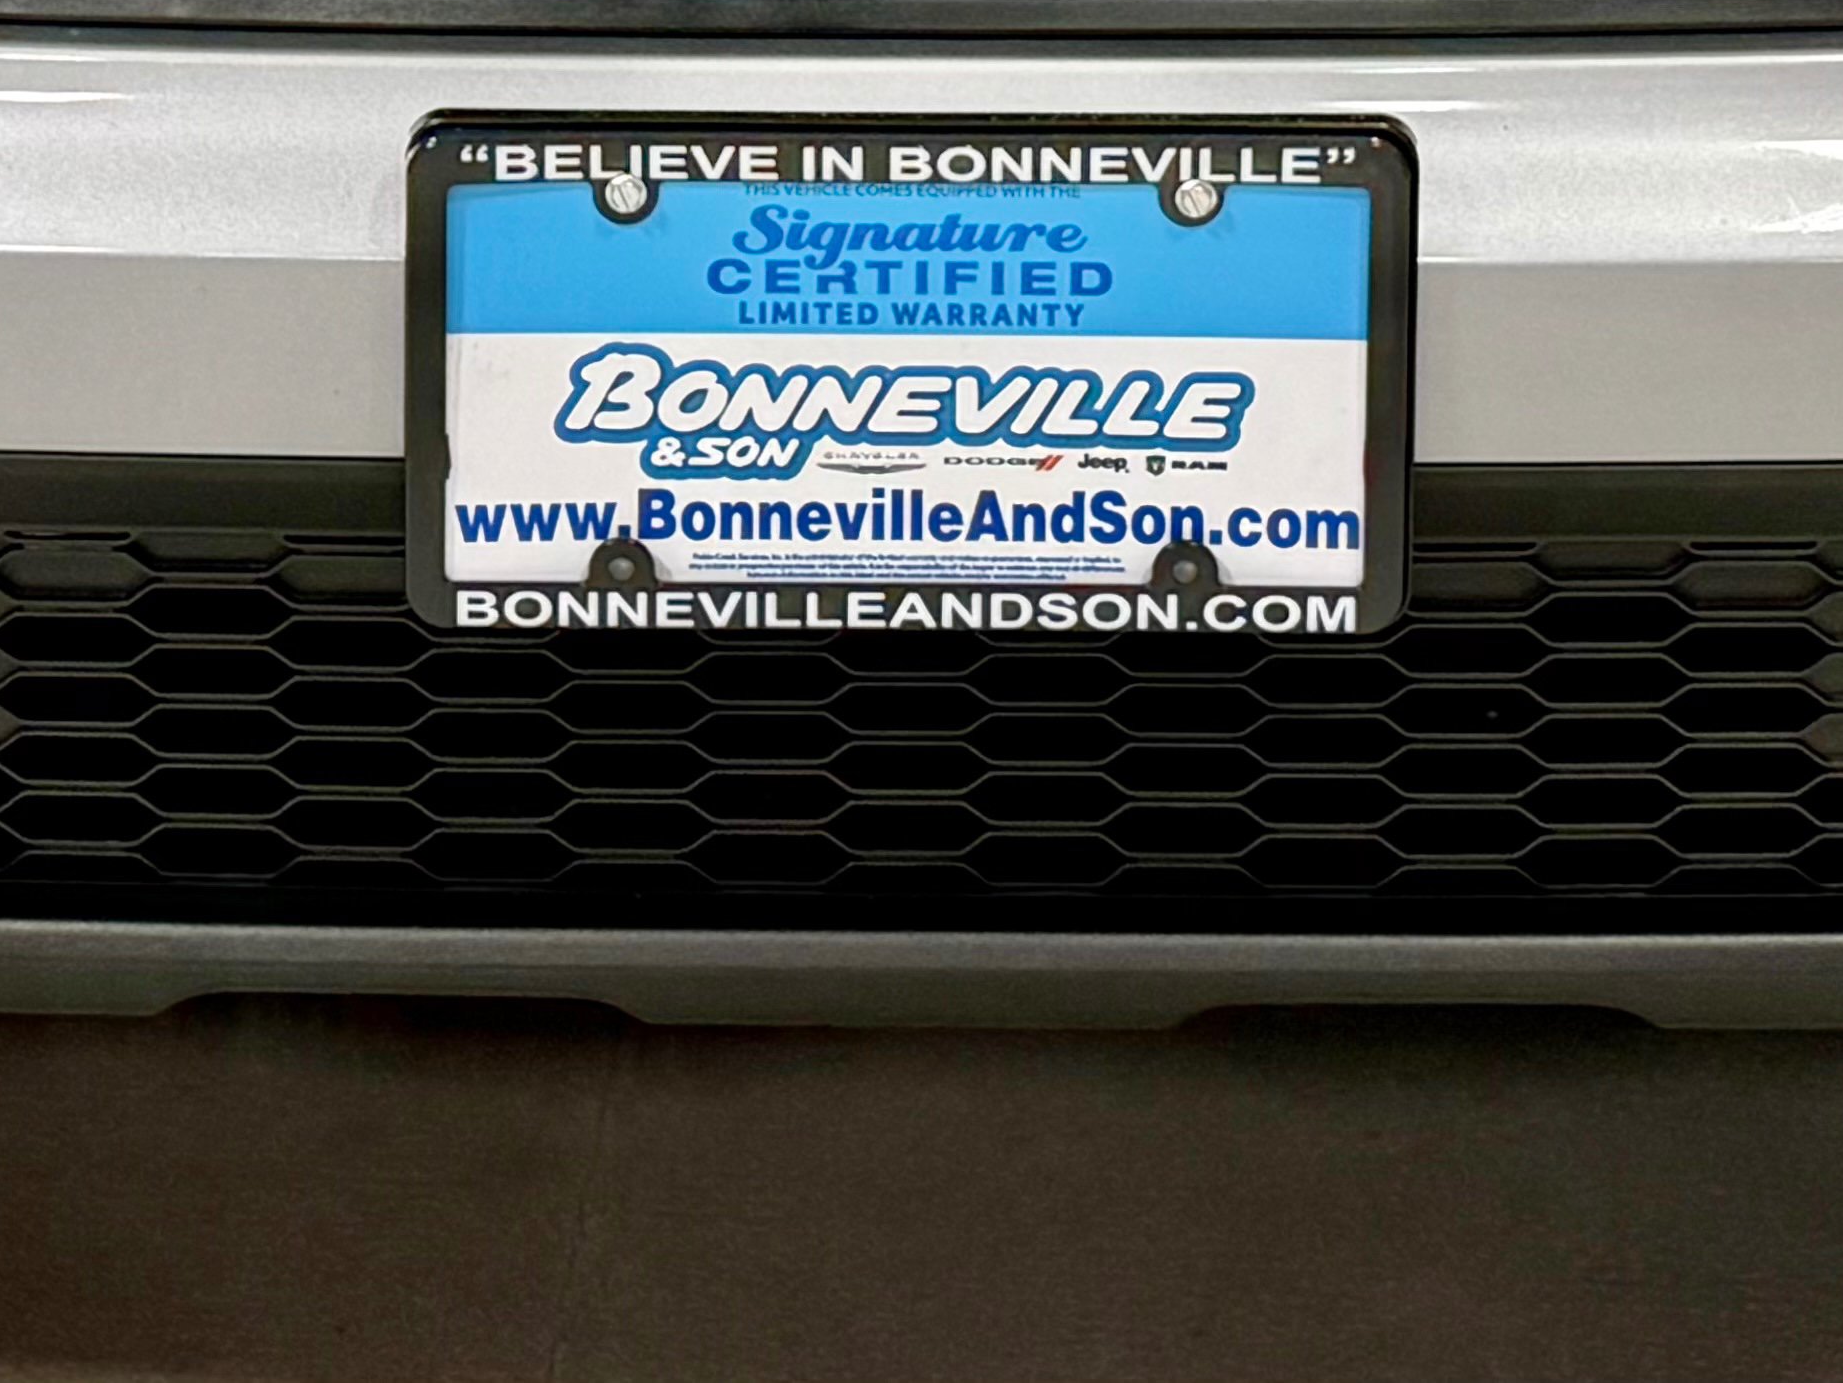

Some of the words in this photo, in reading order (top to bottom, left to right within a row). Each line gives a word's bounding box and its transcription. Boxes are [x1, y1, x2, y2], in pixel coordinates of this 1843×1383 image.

[459, 143, 780, 181] “BELIEVE
[802, 144, 864, 182] IN
[888, 144, 1357, 184] BONNEVILLE”
[745, 184, 780, 197] THIS
[783, 184, 851, 197] VEHICLE
[855, 184, 913, 197] COMES
[1002, 184, 1046, 198] WITH
[1050, 184, 1081, 198] THE
[731, 203, 1088, 270] Signature
[706, 257, 1114, 297] CERTIFIED
[739, 300, 879, 325] LIMITED
[892, 302, 1085, 327] WARRANTY
[561, 349, 1246, 442] BONNEVILLE
[1077, 453, 1128, 473] Jeep
[1171, 460, 1228, 471] RAM
[454, 487, 1361, 550] www.BonnevilleAndSon.com
[455, 589, 1358, 633] BONNEVILLEANDSON.COM
